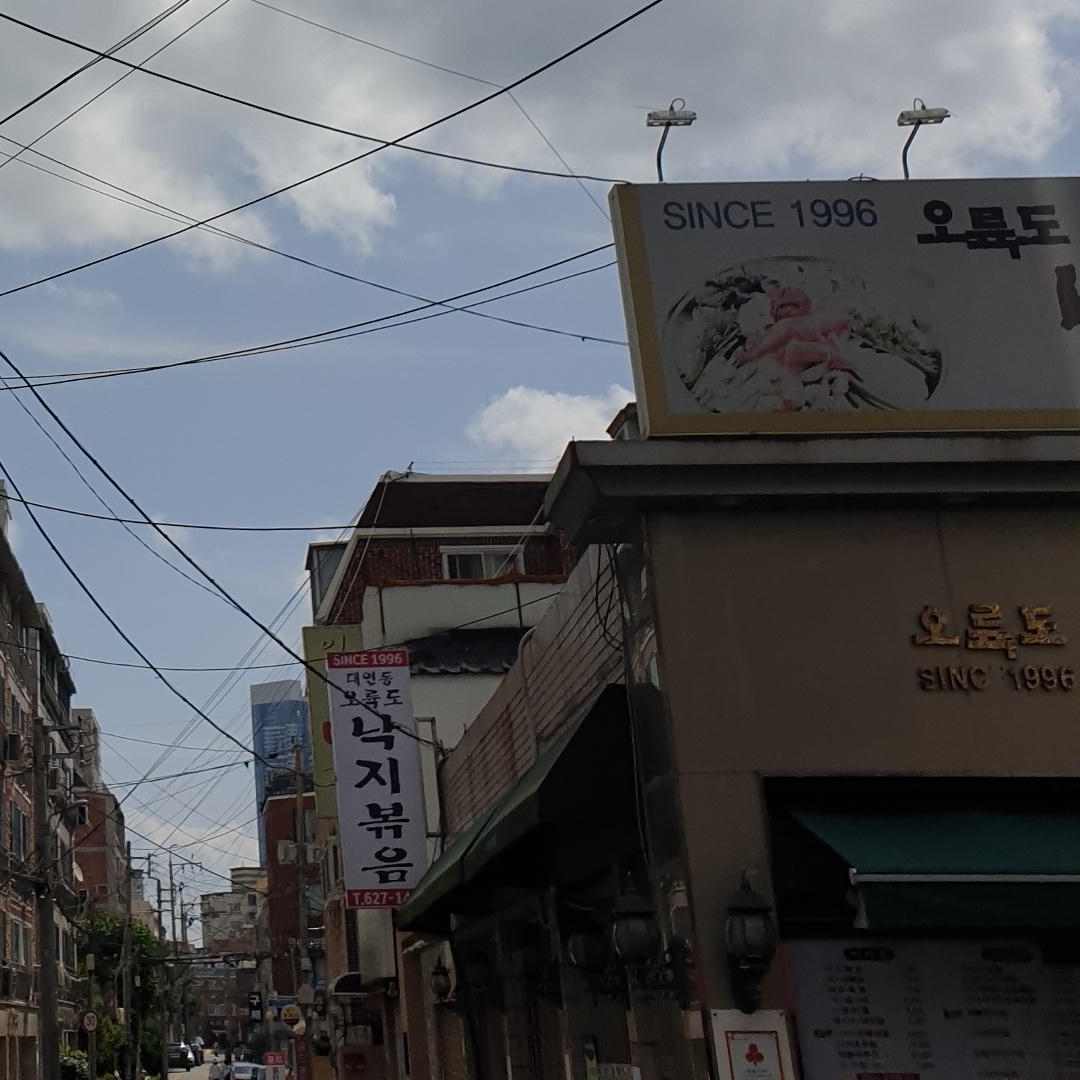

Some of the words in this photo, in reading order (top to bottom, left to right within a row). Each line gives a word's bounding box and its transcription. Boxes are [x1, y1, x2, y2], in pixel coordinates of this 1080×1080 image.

[663, 199, 776, 232] SINCE
[790, 197, 879, 229] 1996
[917, 199, 1071, 260] 오륙도
[912, 603, 1068, 661] 오륙도
[332, 654, 369, 666] SINCE
[372, 653, 403, 665] 1996
[346, 671, 394, 687] 대연동
[1007, 664, 1075, 692] 1996
[340, 689, 404, 709] 오륙도
[351, 715, 415, 884] 낙지볶음
